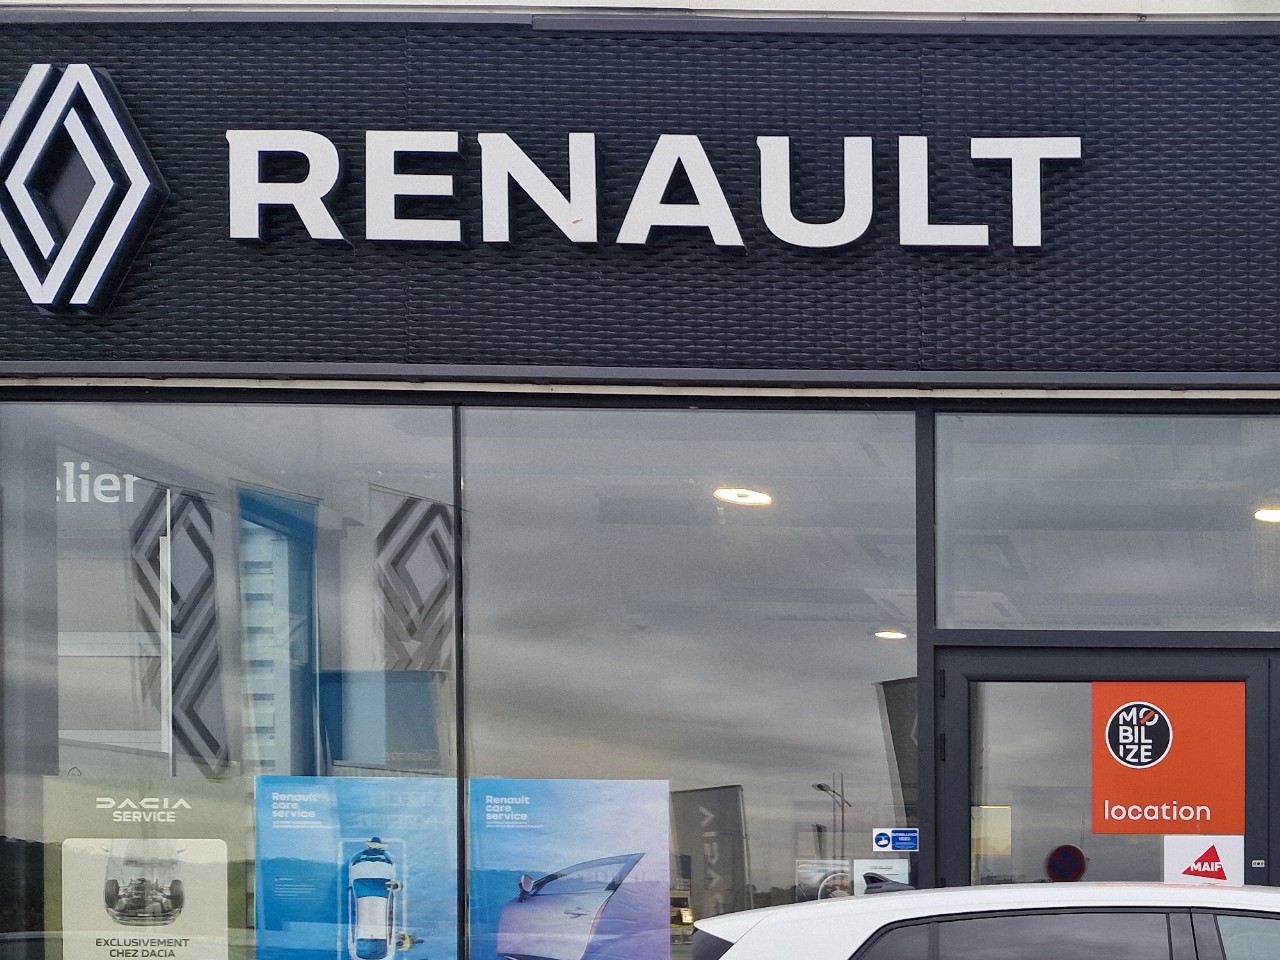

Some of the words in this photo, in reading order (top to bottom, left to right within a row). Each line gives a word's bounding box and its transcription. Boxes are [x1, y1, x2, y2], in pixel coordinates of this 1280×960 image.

[226, 129, 1083, 248] RENAULT
[56, 461, 141, 503] lier
[271, 792, 319, 802] Renault
[485, 795, 531, 804] Renault
[95, 797, 192, 809] DACIA
[271, 802, 299, 810] care
[485, 803, 512, 812] care
[271, 808, 316, 818] service
[1104, 799, 1211, 821] location
[112, 811, 176, 822] SERVICE
[485, 811, 528, 821] service
[1190, 861, 1222, 872] MAIF
[95, 938, 190, 947] EXCLUSIVEMENT
[109, 949, 138, 958] CHEZ
[141, 949, 176, 958] DACIA
